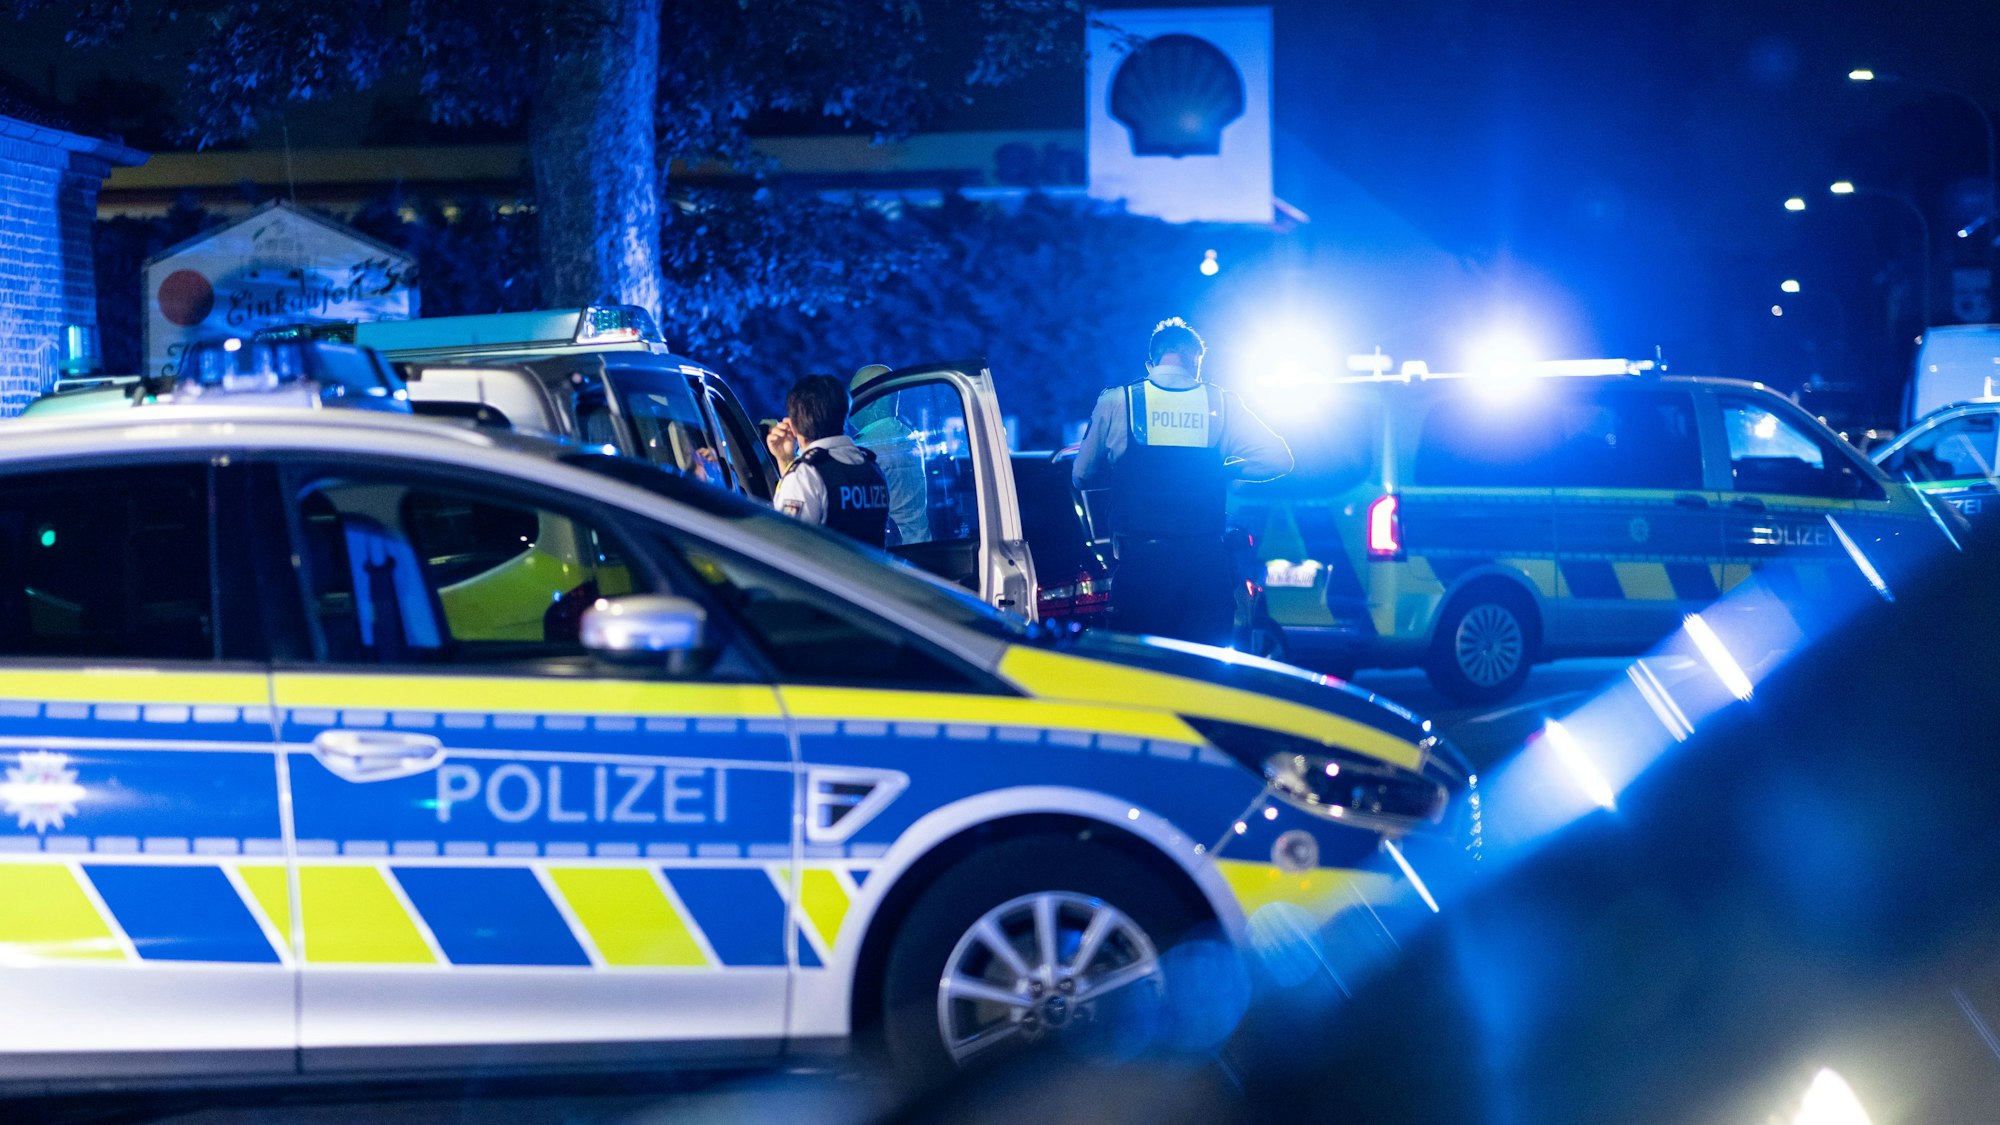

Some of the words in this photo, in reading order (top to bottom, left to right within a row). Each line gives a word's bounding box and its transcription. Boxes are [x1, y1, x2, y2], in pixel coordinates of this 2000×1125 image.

[1151, 410, 1204, 430] POLIZEI
[839, 485, 890, 511] POLIZE
[436, 763, 728, 824] POLIZEI
